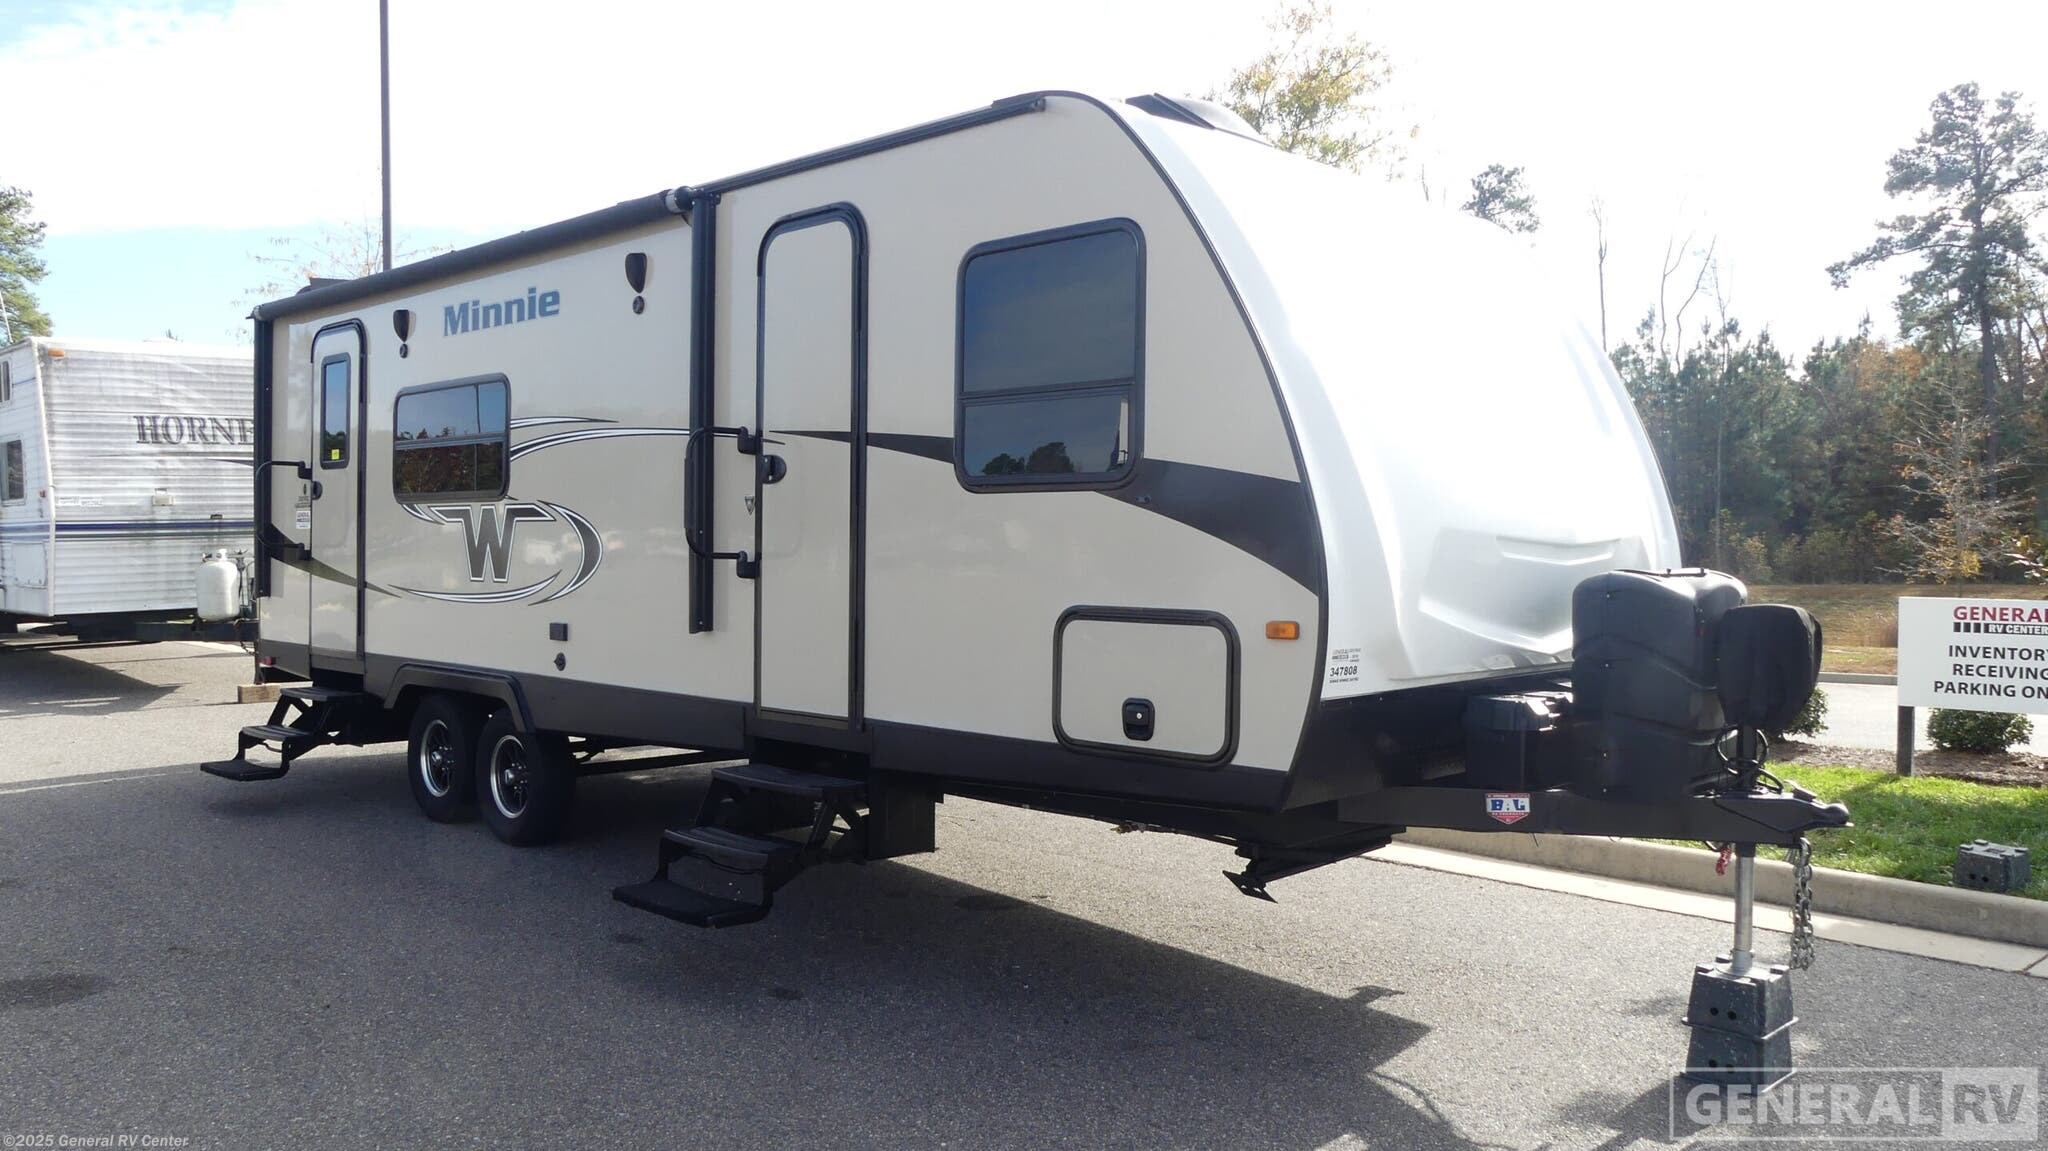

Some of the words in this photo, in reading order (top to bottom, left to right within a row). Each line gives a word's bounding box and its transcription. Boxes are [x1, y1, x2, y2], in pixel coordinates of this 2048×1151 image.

[444, 287, 560, 337] Minnie
[1988, 624, 2005, 634] RV
[2005, 624, 2048, 636] CENTER
[1949, 645, 2048, 662] INVENTOR
[1330, 666, 1358, 677] 347808
[1934, 681, 2016, 698] PARKING
